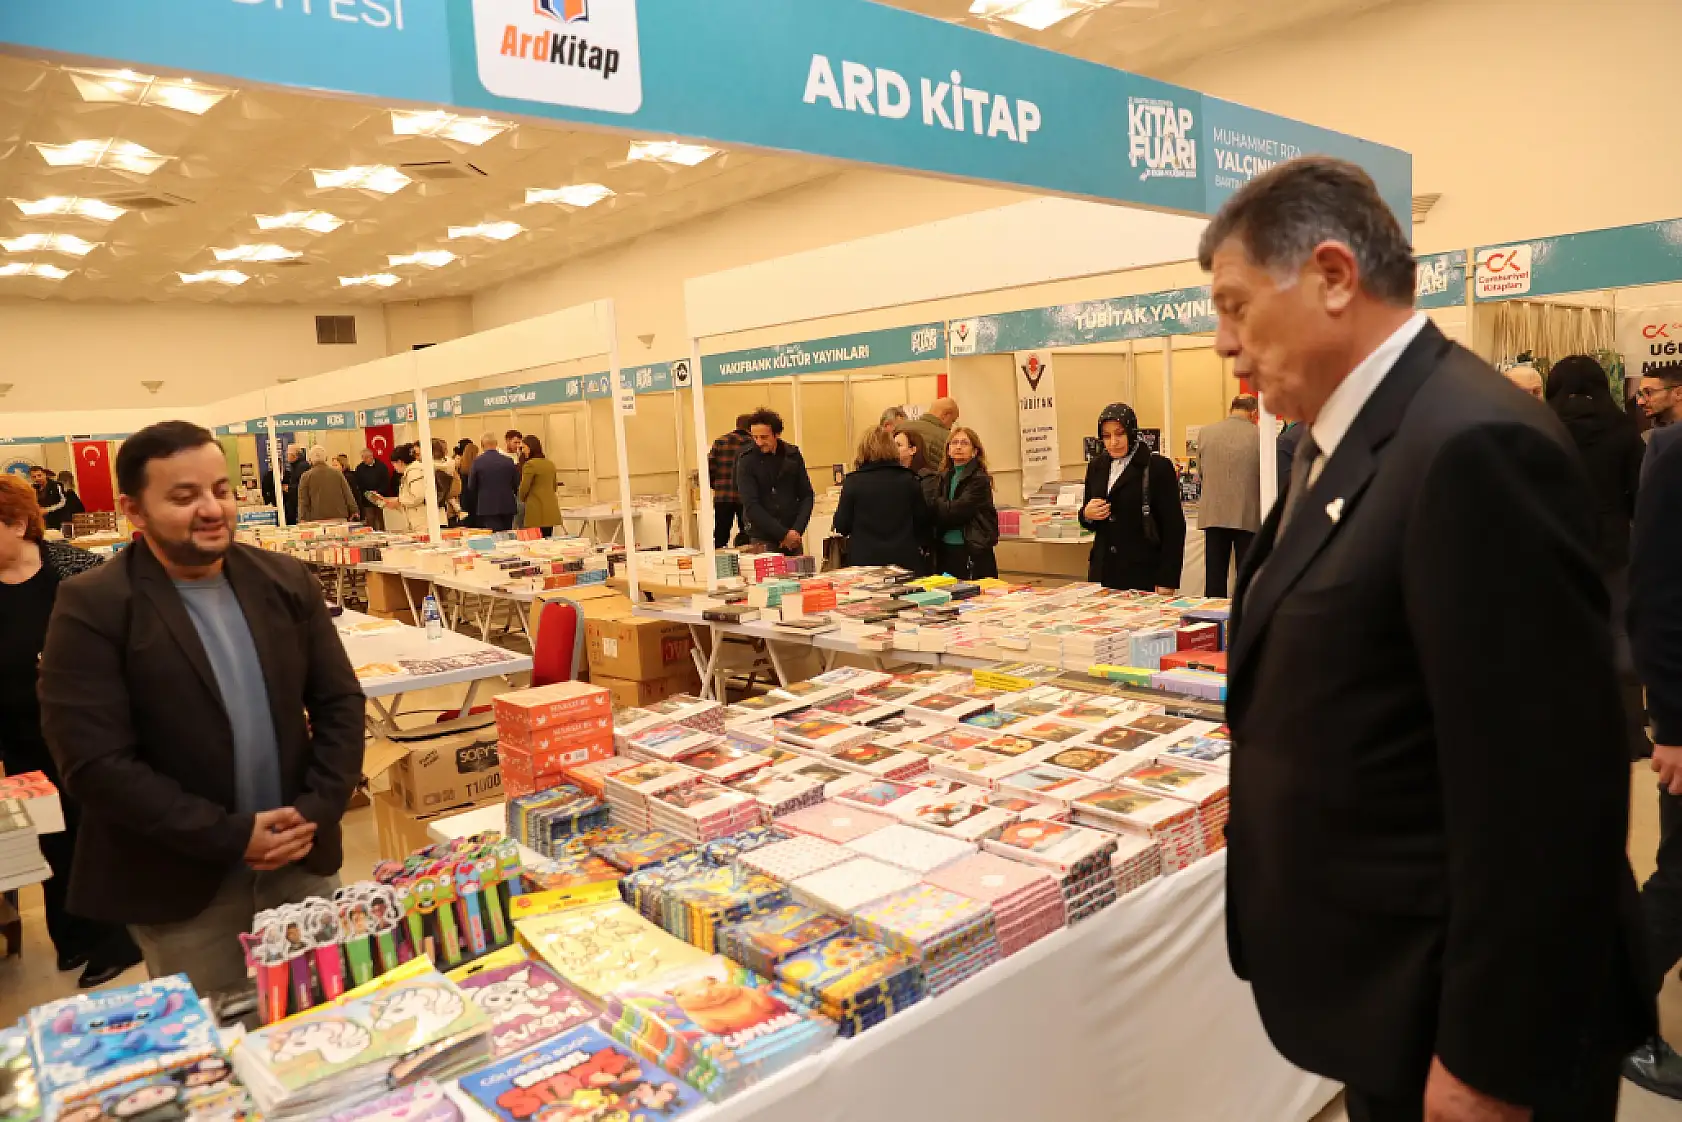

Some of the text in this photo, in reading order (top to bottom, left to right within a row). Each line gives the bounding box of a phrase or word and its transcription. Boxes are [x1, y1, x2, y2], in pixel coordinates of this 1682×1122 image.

[500, 24, 620, 80] ArdKitap
[803, 53, 1042, 144] ARD KİTAP
[1213, 126, 1279, 156] MUHAMMET
[1478, 271, 1530, 284] Cumhuriyet
[1073, 306, 1148, 331] TÜBİTAK
[719, 343, 870, 376] VAKIFBANK KÜLTÜR YAYINLARI
